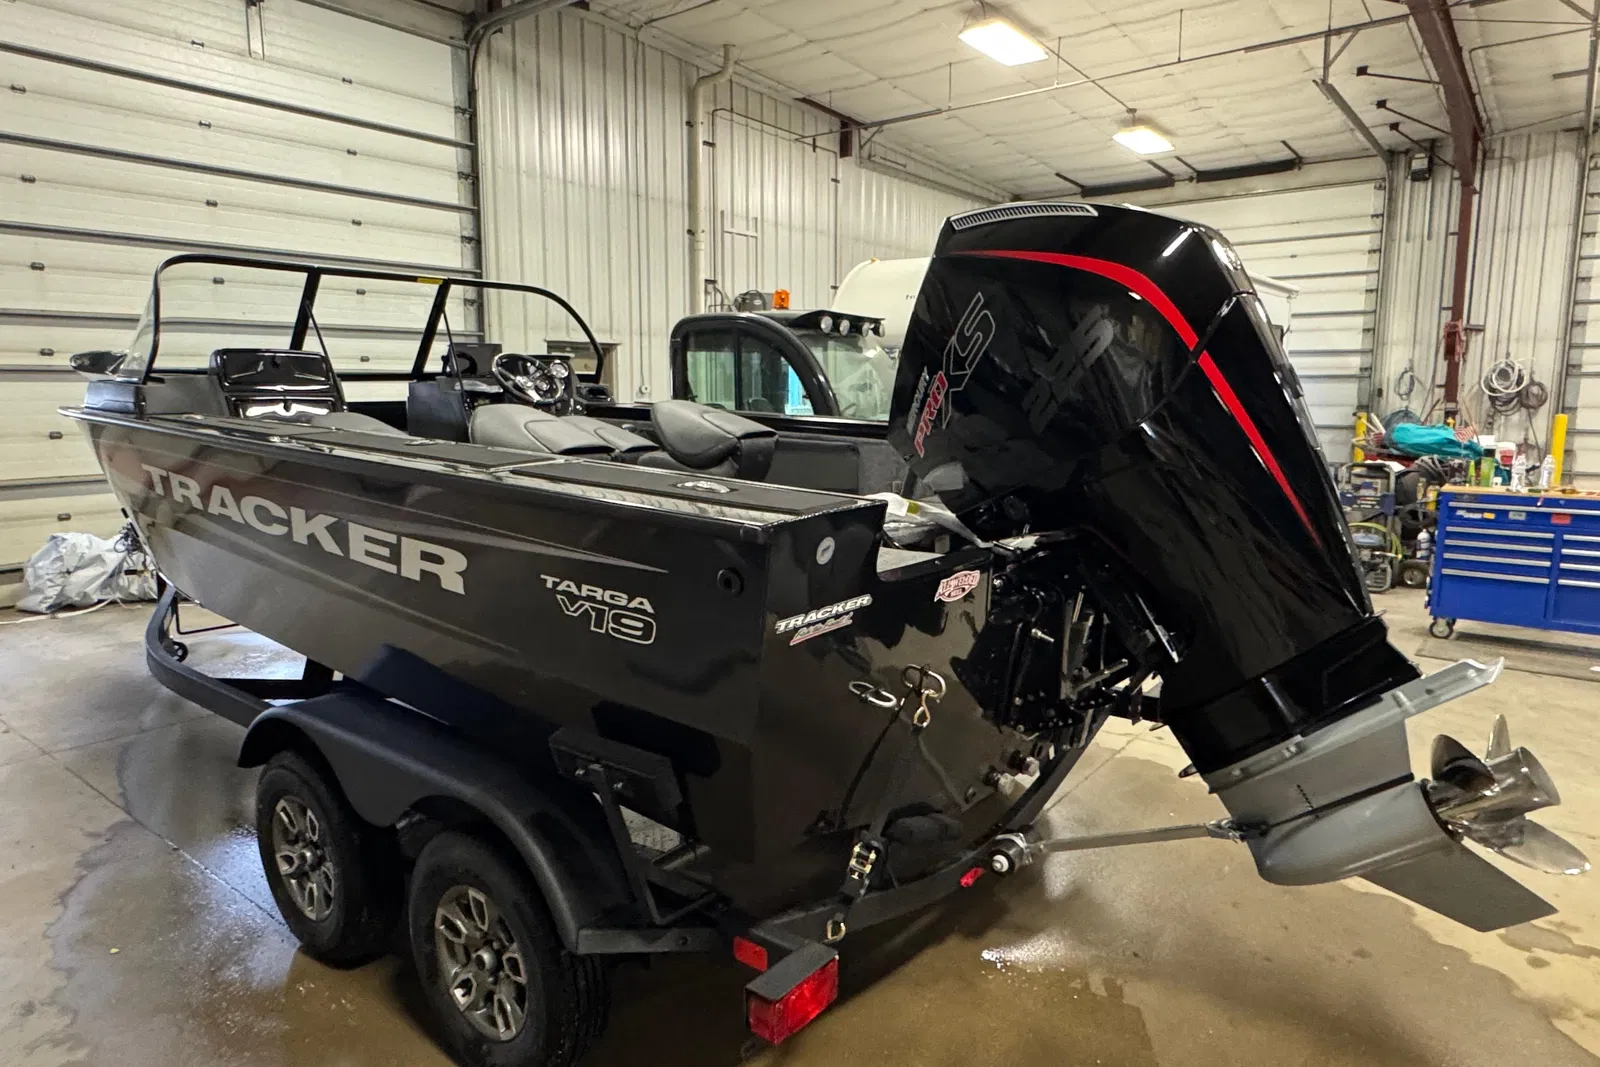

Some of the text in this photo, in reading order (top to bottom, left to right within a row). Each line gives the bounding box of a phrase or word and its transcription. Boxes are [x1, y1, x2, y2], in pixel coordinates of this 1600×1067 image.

[914, 292, 995, 457] PRO XS
[141, 464, 468, 596] TRACKER
[541, 574, 656, 614] TARGA
[775, 594, 873, 634] TRACKER
[556, 595, 657, 645] V19
